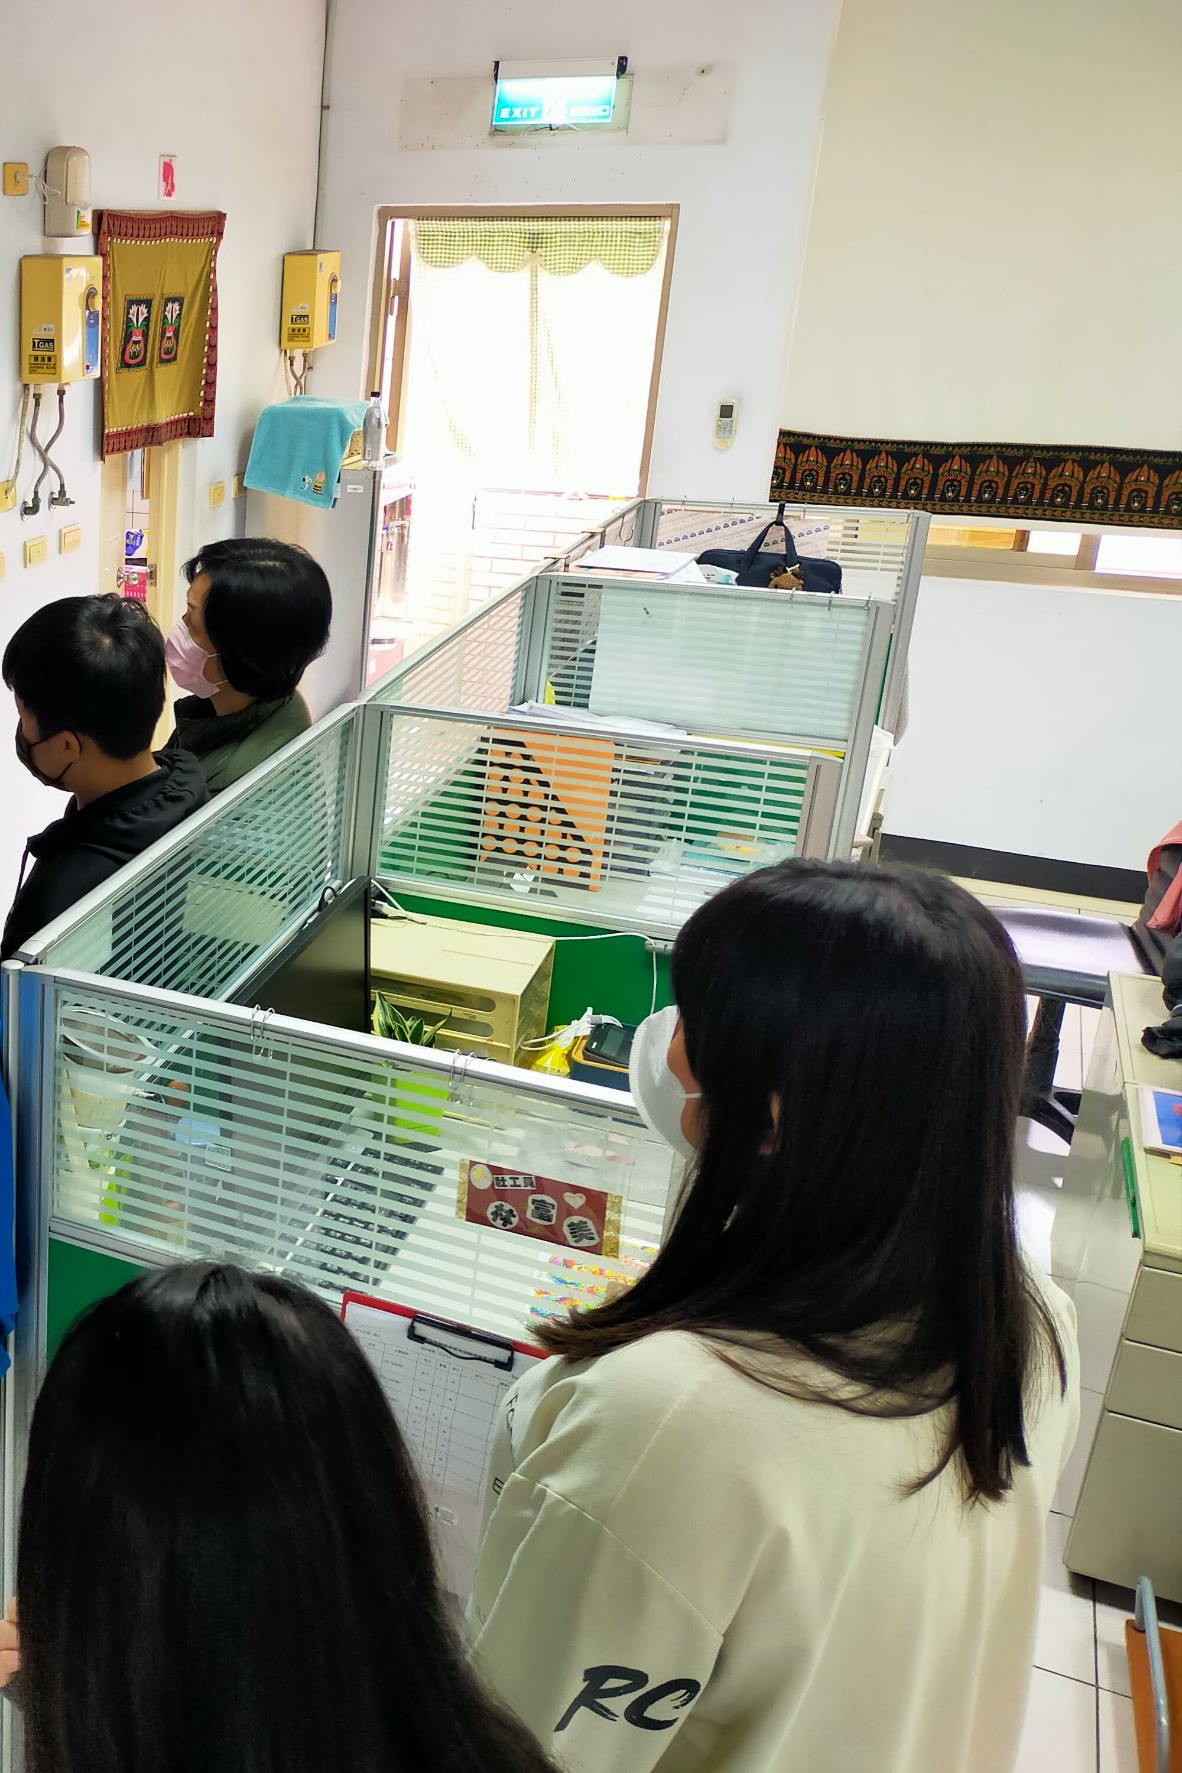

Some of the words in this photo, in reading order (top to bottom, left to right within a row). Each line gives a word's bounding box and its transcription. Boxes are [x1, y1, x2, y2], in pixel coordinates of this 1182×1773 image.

[499, 106, 539, 119] EXIT
[494, 1176, 535, 1188] 社工員
